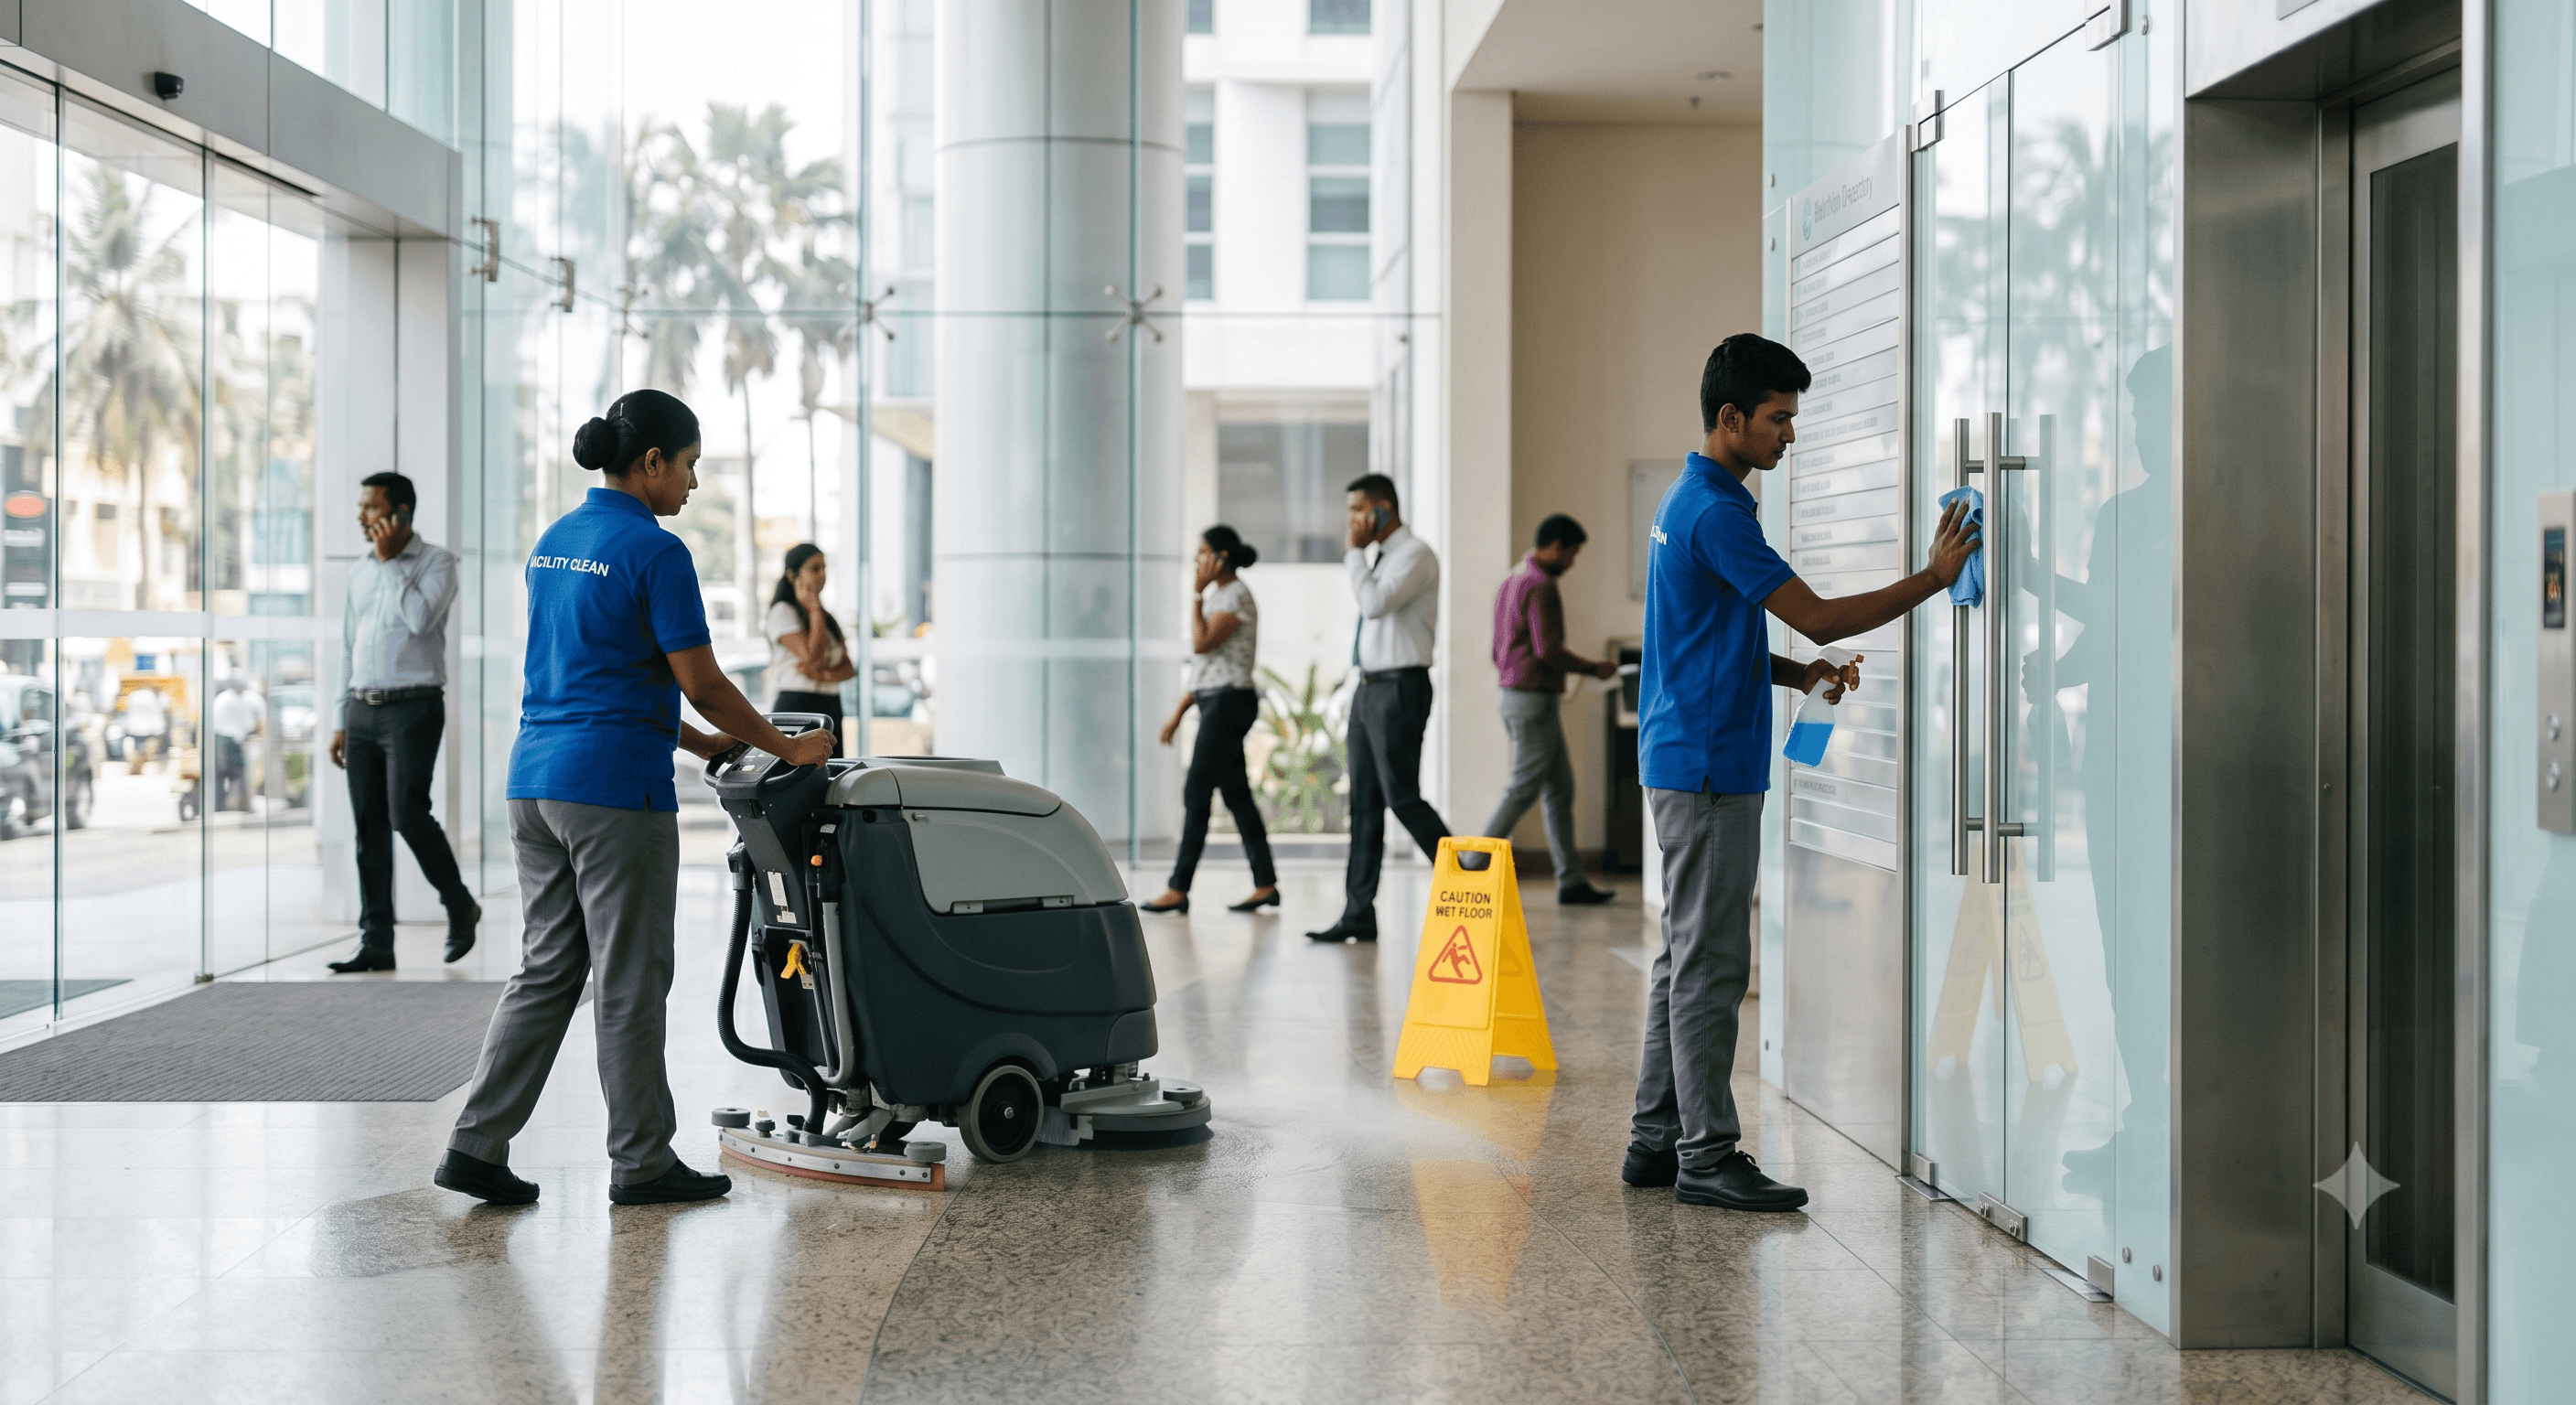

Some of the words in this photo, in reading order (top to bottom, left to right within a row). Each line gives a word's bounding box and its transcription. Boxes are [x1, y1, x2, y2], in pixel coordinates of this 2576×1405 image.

[570, 558, 609, 577] CLEAN
[1440, 890, 1491, 905] CAUTION
[1435, 906, 1456, 917] WET
[1458, 906, 1493, 919] FLOOR
